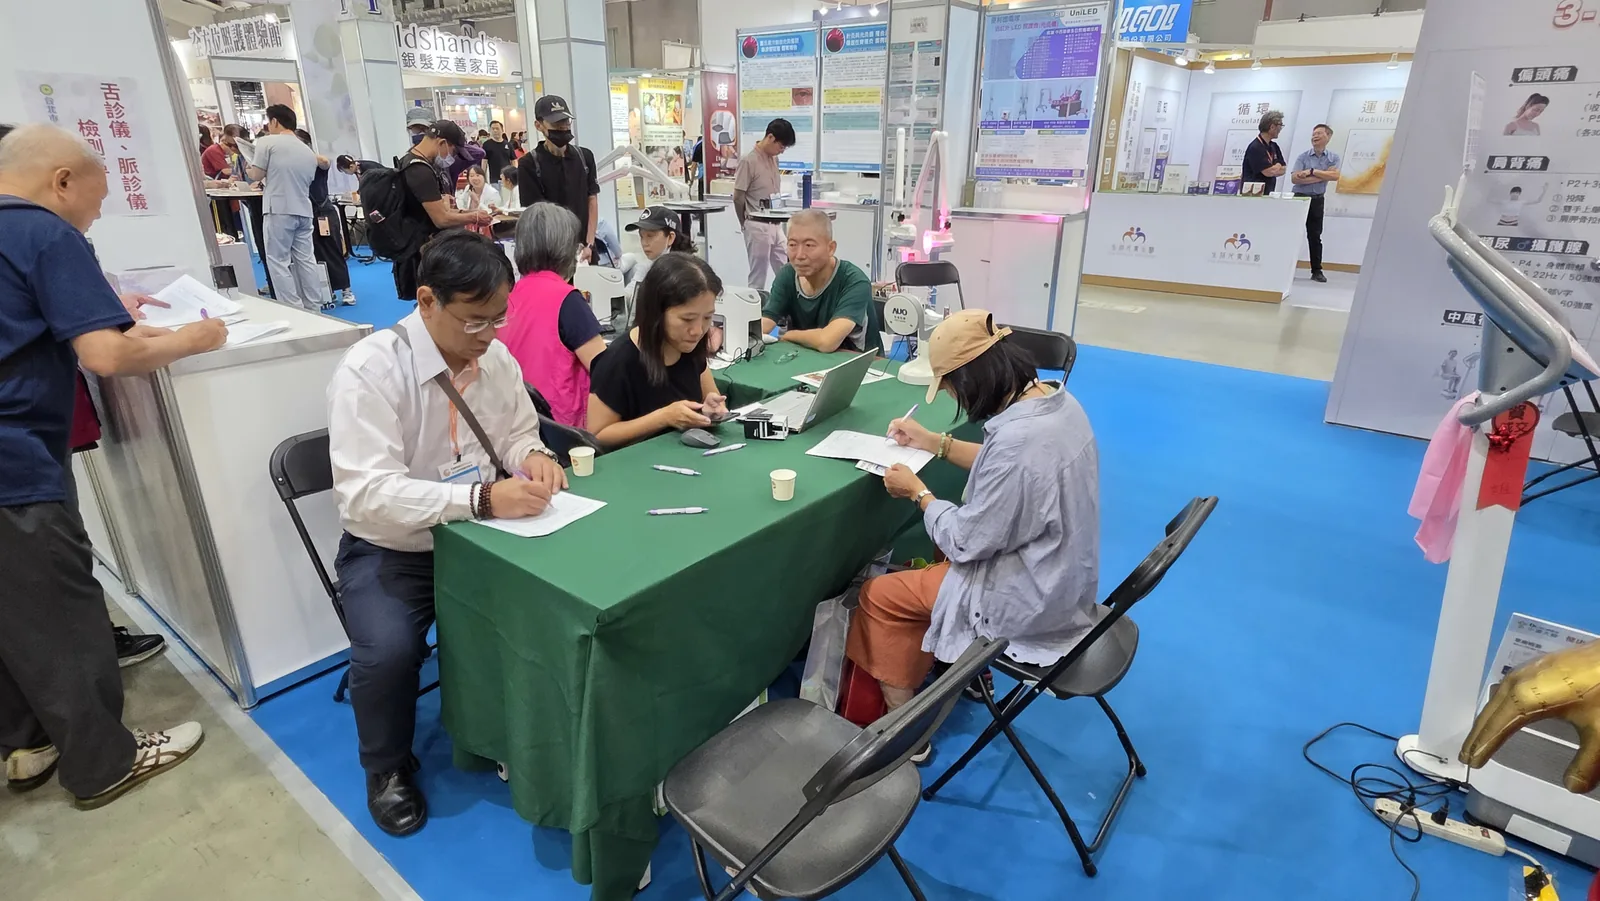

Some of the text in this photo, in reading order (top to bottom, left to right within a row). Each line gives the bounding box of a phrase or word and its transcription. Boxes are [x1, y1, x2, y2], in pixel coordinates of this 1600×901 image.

[1070, 8, 1098, 16] UniLED
[191, 18, 283, 58] 全方位照護體驗館
[401, 51, 499, 75] 銀髮友善家居
[1518, 67, 1571, 82] 偏頭痛
[1238, 102, 1270, 115] 循環
[1361, 101, 1398, 114] 運動
[1357, 116, 1394, 124] Mobility
[100, 82, 148, 210] 舌診儀、脈診儀
[1492, 156, 1544, 170] 肩背痛
[1531, 239, 1583, 254] 攝護腺
[1532, 271, 1558, 279] 22Hz
